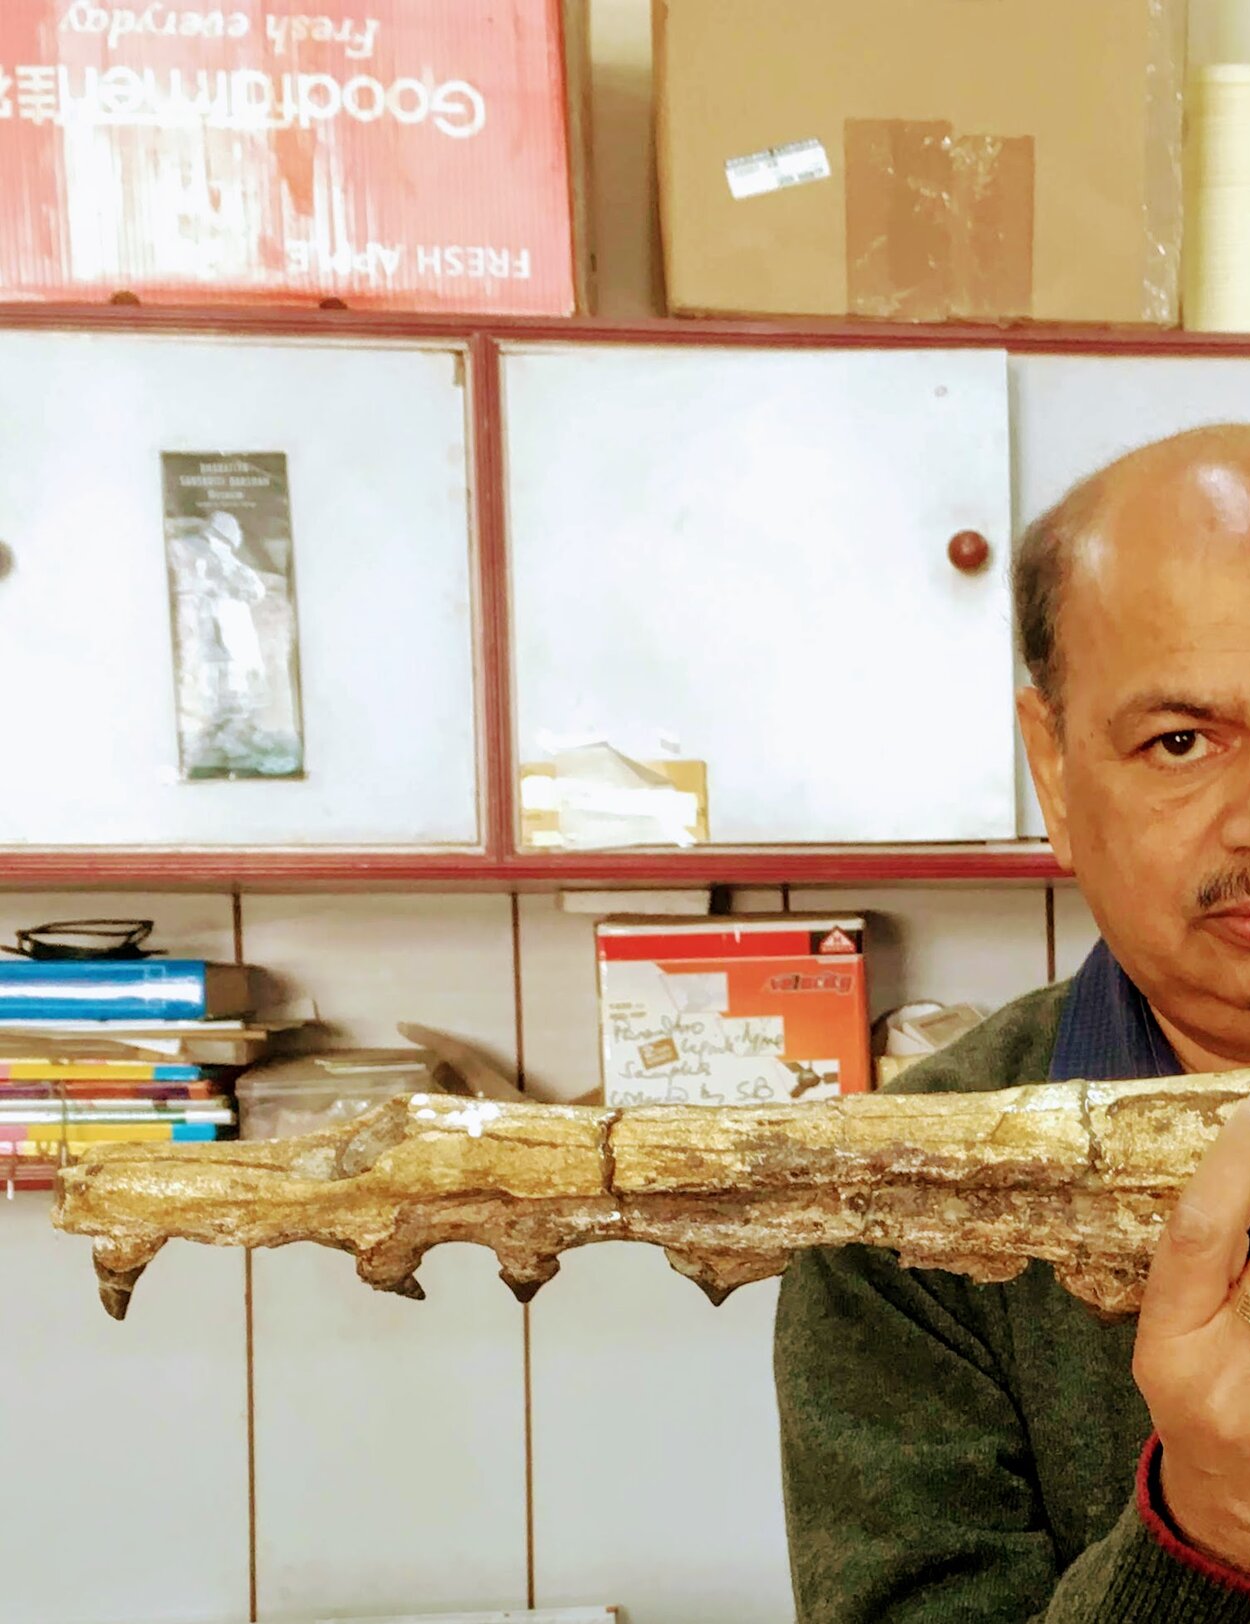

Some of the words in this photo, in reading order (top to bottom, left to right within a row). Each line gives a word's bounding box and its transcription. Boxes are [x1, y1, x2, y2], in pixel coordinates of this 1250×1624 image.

[60, 4, 249, 49] everyday
[267, 16, 380, 58] Fresh
[416, 246, 530, 279] FRESH
